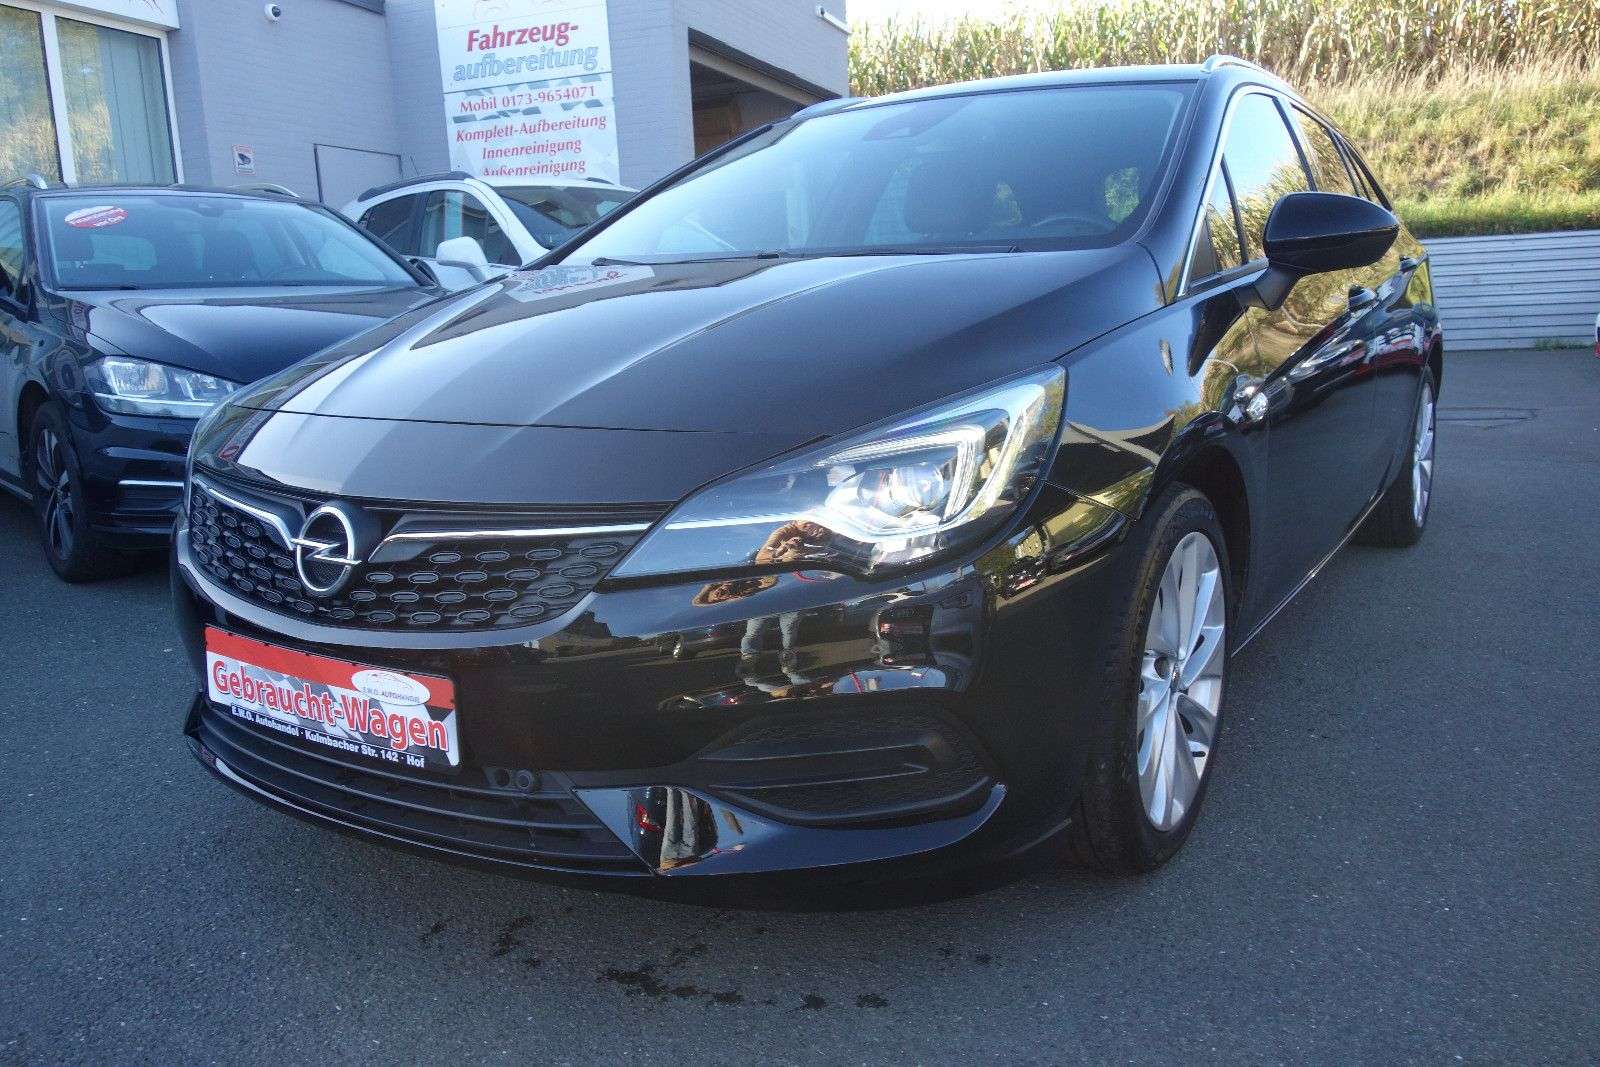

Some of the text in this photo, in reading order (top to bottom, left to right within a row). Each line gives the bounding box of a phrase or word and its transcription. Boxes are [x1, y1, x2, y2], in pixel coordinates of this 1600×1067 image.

[466, 22, 579, 52] Fahrzeug-
[453, 45, 599, 81] aufbereitung
[460, 86, 596, 112] Mobil 0173-9654071
[456, 115, 607, 143] Komplett-Aufbereitung
[482, 139, 582, 160] Innenreinigung
[212, 660, 449, 751] Gebraucht-Wagen
[255, 713, 299, 737] Autohandel
[305, 730, 360, 753] Kulmbacher
[361, 745, 379, 757] Str.
[380, 750, 399, 762] 142
[406, 755, 425, 768] Hof
